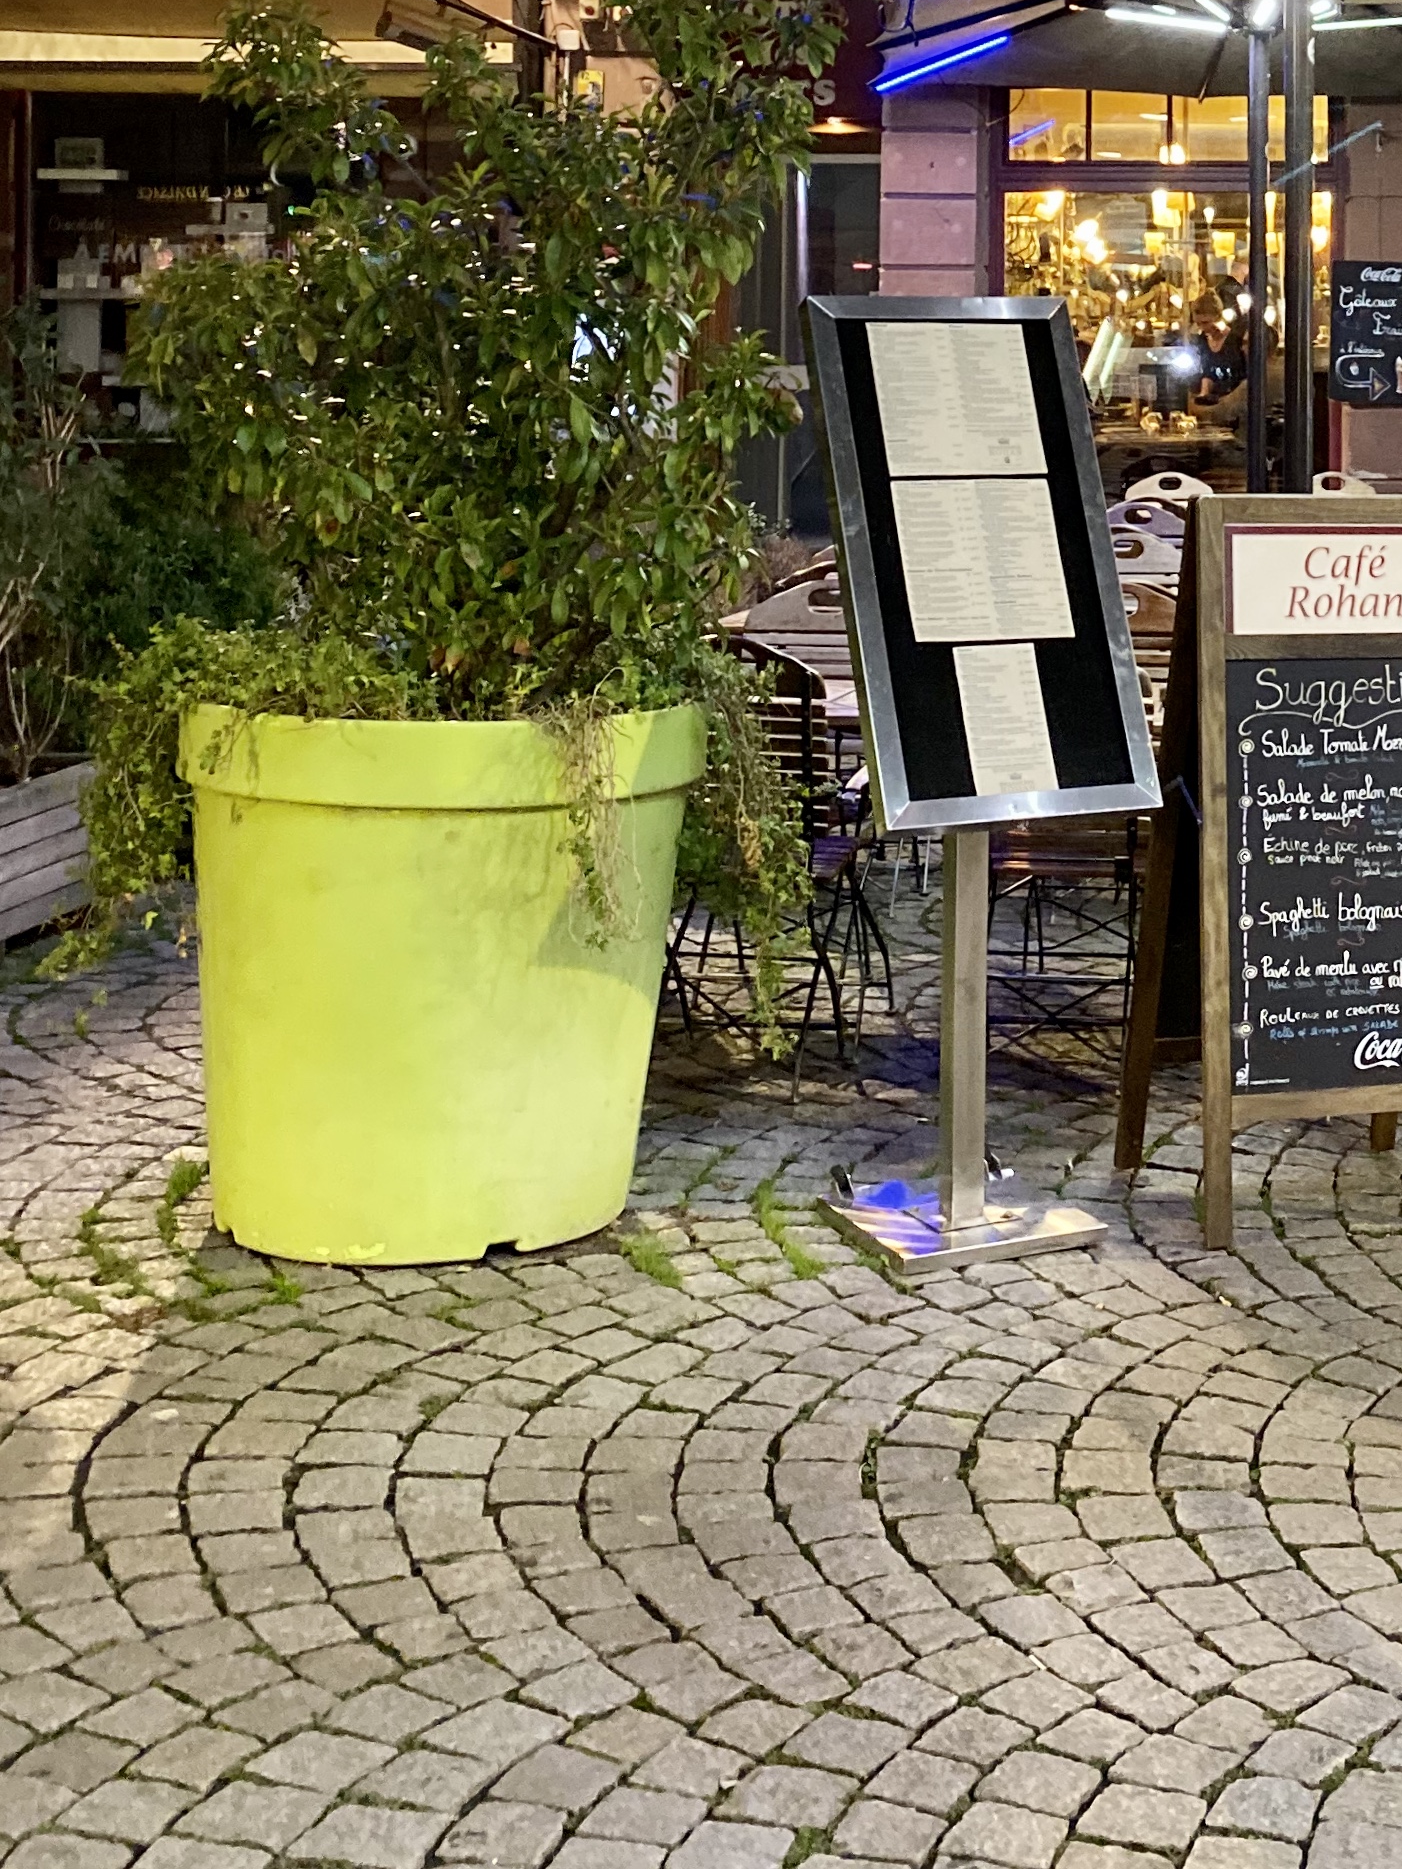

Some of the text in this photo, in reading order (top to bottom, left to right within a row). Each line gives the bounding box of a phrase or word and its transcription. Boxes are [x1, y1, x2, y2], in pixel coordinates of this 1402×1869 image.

[1304, 544, 1388, 586] Café
[1261, 728, 1314, 758] Salade
[1319, 729, 1371, 754] Tomate
[1257, 778, 1313, 806] Salade
[1320, 783, 1338, 803] de
[1262, 805, 1292, 830] fumé
[1312, 801, 1366, 827] beaufort
[1315, 837, 1331, 854] de
[1257, 896, 1330, 938] Spaghetti
[1260, 955, 1292, 979] Pavé
[1294, 955, 1312, 978] de
[1314, 950, 1359, 977] merlu
[1361, 960, 1391, 975] avec
[1369, 975, 1385, 989] ou
